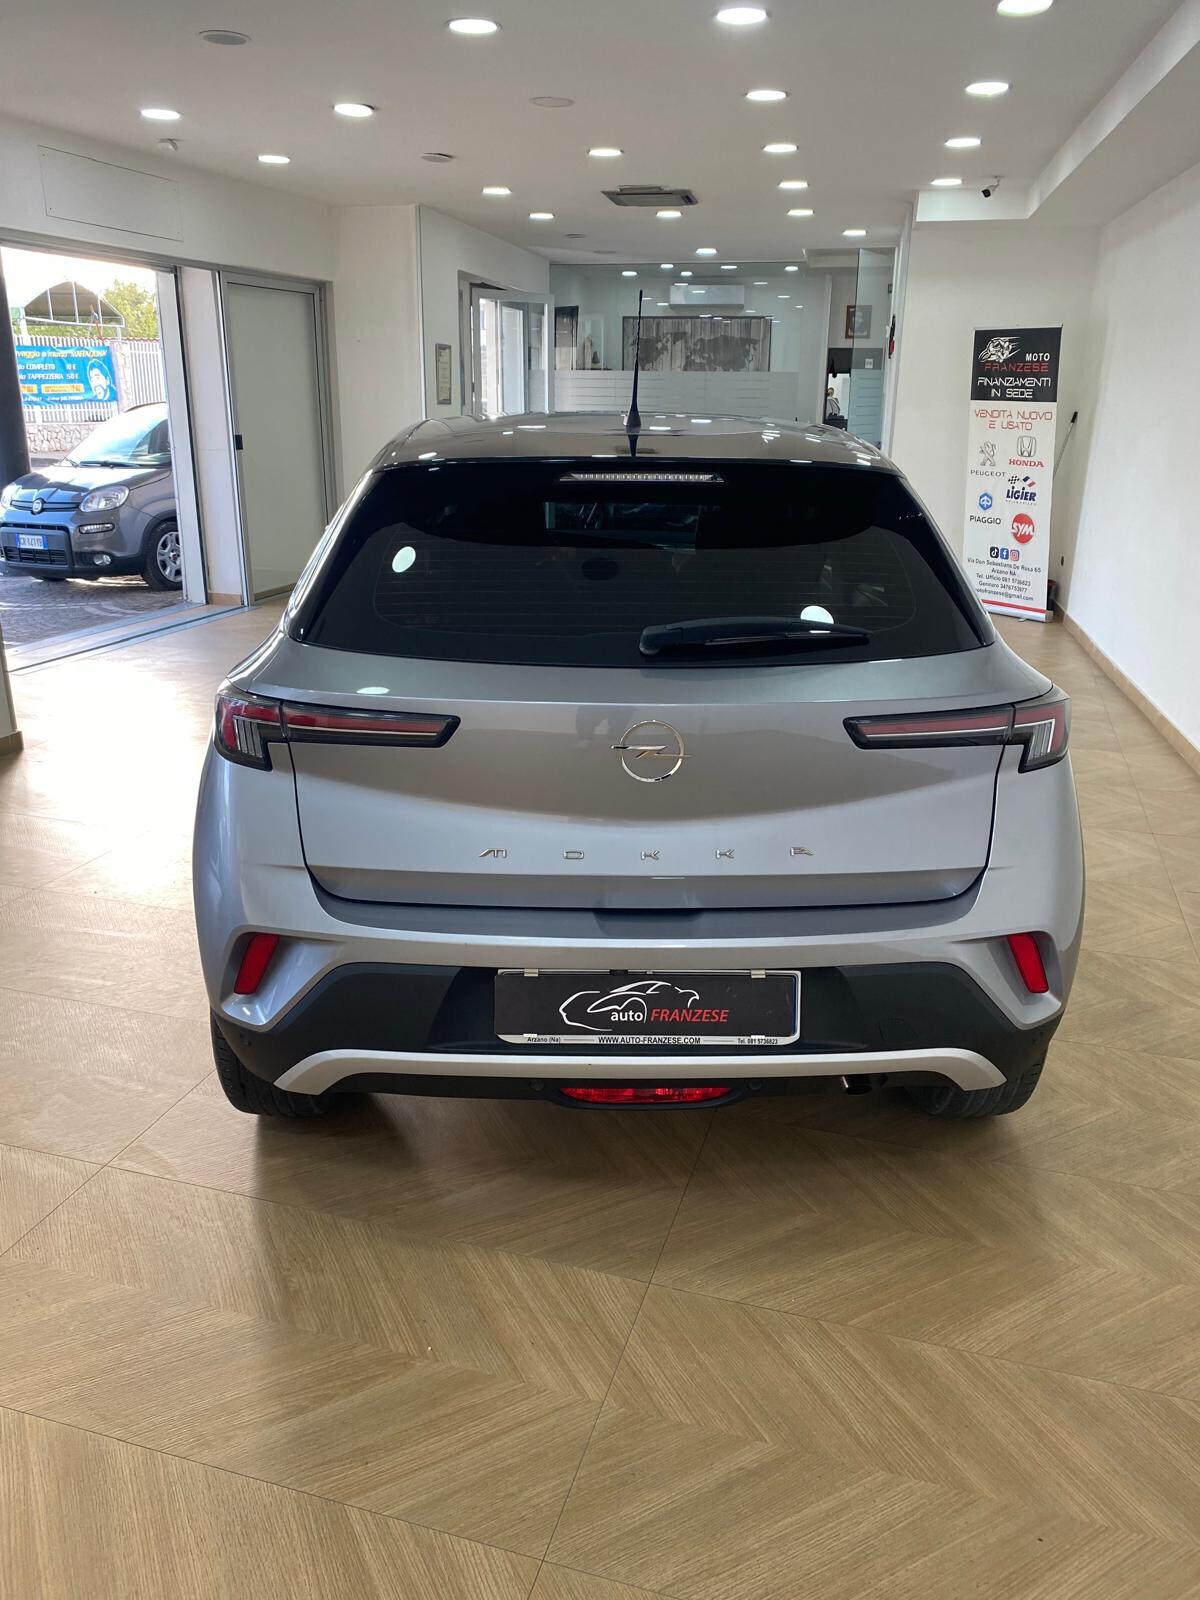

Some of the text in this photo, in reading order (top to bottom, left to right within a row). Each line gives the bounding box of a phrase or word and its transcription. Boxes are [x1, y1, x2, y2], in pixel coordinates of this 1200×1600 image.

[1025, 353, 1050, 361] MOTO
[984, 363, 1049, 372] FRANZESE
[977, 377, 1051, 387] FINANZIAMENTI
[991, 388, 1033, 398] IN SEDE
[975, 409, 1052, 420] VENDITA NUOVO
[1001, 421, 1032, 430] USATO
[1008, 459, 1044, 467] HONDA
[970, 469, 1006, 477] PEUGEOT
[969, 515, 1002, 524] PIAGGIO
[1011, 522, 1034, 536] SYM
[991, 568, 1008, 576] Arzano
[479, 846, 814, 860] MOKKA
[611, 1009, 729, 1022] auto FRANZESE
[598, 1036, 701, 1044] WWW.AUTO-FRANZESE.COM
